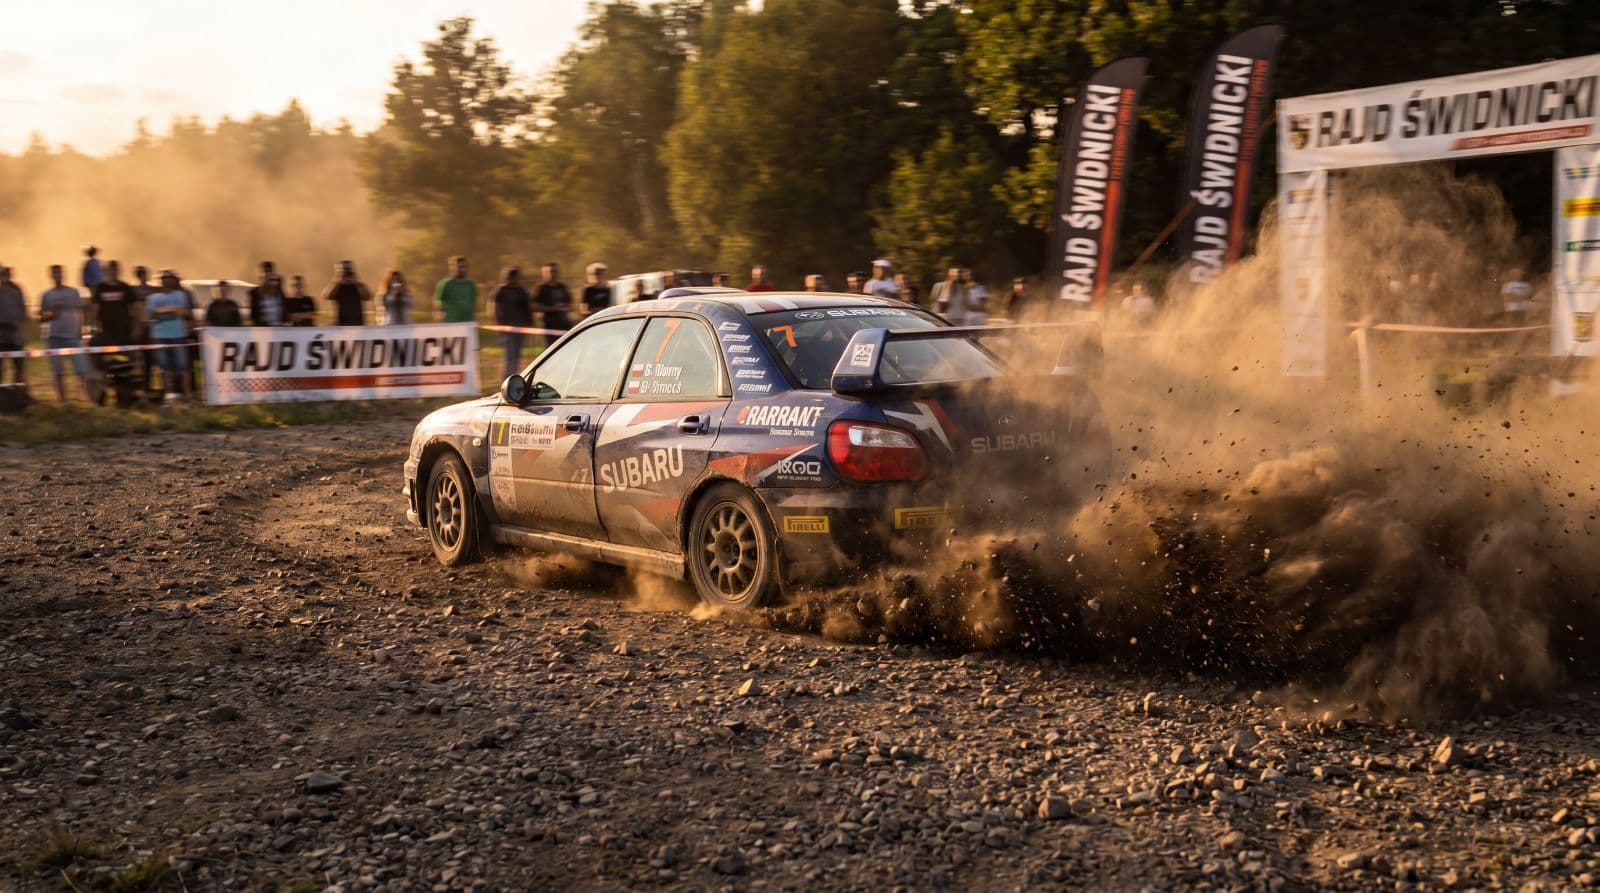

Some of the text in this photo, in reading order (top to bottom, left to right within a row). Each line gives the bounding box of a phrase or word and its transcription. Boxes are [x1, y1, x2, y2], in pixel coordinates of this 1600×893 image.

[1190, 54, 1254, 208] ŚWIDNICKI
[1316, 103, 1393, 148] RAJD
[1400, 75, 1600, 139] ŚWIDNICKI
[1060, 84, 1122, 303] RAJD ŚWIDNICKI
[1190, 216, 1229, 285] RAJD
[217, 333, 469, 373] RAJD ŚWIDNICKI
[655, 319, 681, 363] 7
[772, 325, 798, 348] 7
[600, 443, 684, 493] SUBARU
[787, 518, 825, 531] PIRELLI
